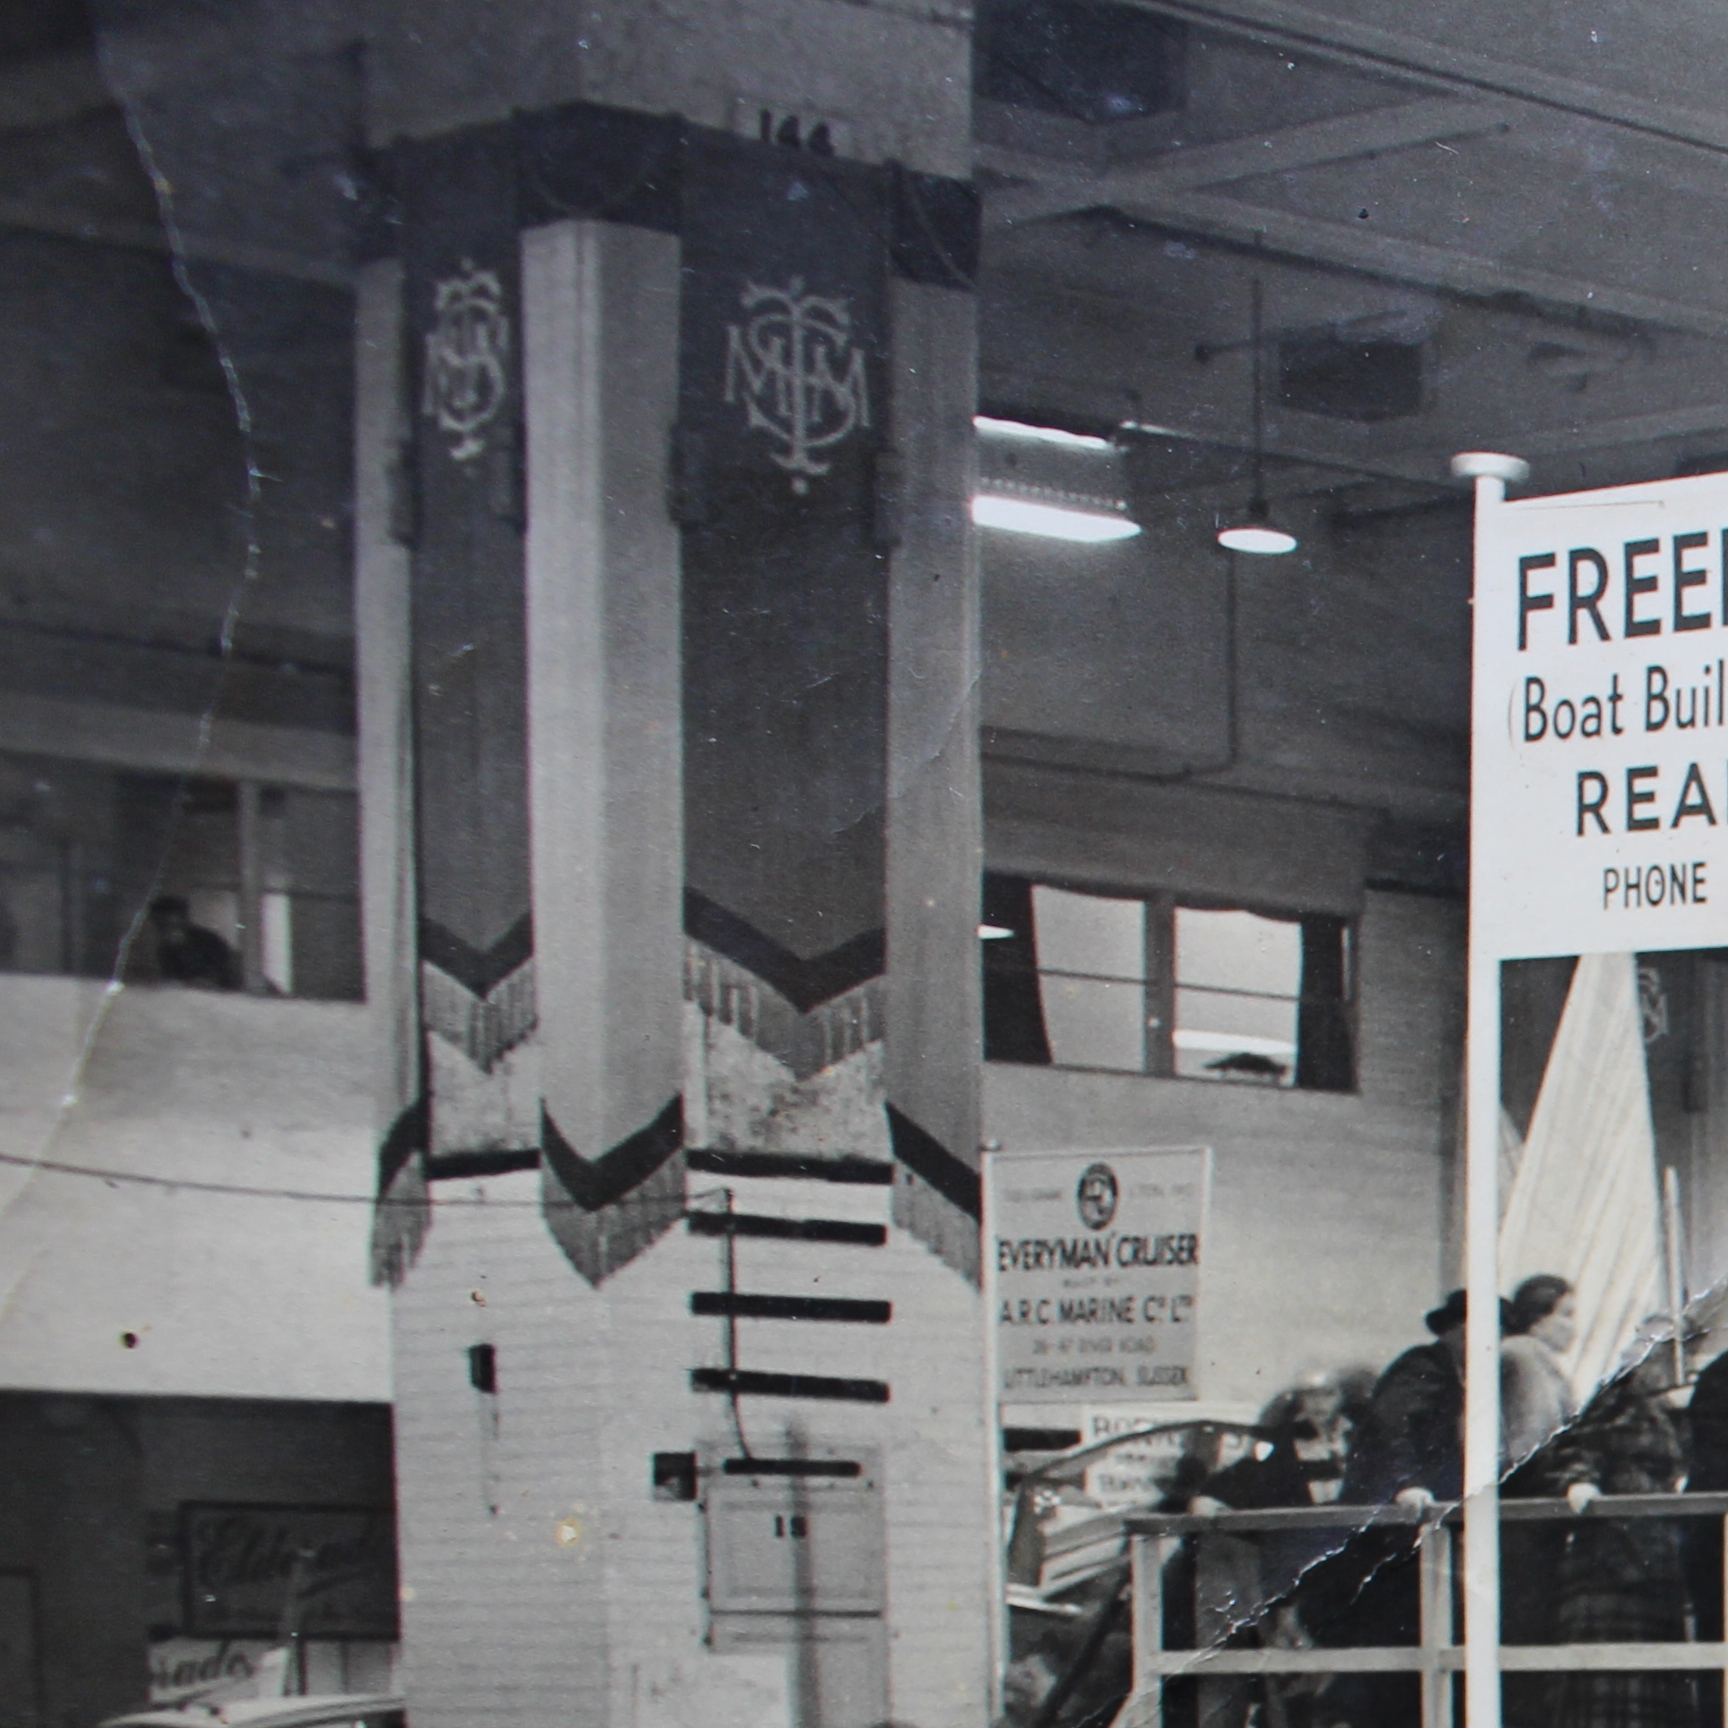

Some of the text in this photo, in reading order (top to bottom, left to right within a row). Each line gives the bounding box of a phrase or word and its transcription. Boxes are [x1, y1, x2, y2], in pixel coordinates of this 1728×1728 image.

[1506, 667, 1624, 748] (Boat
[1602, 860, 1707, 910] PHONE
[1115, 1232, 1200, 1268] CRUISER
[1058, 1296, 1136, 1324] MARINE
